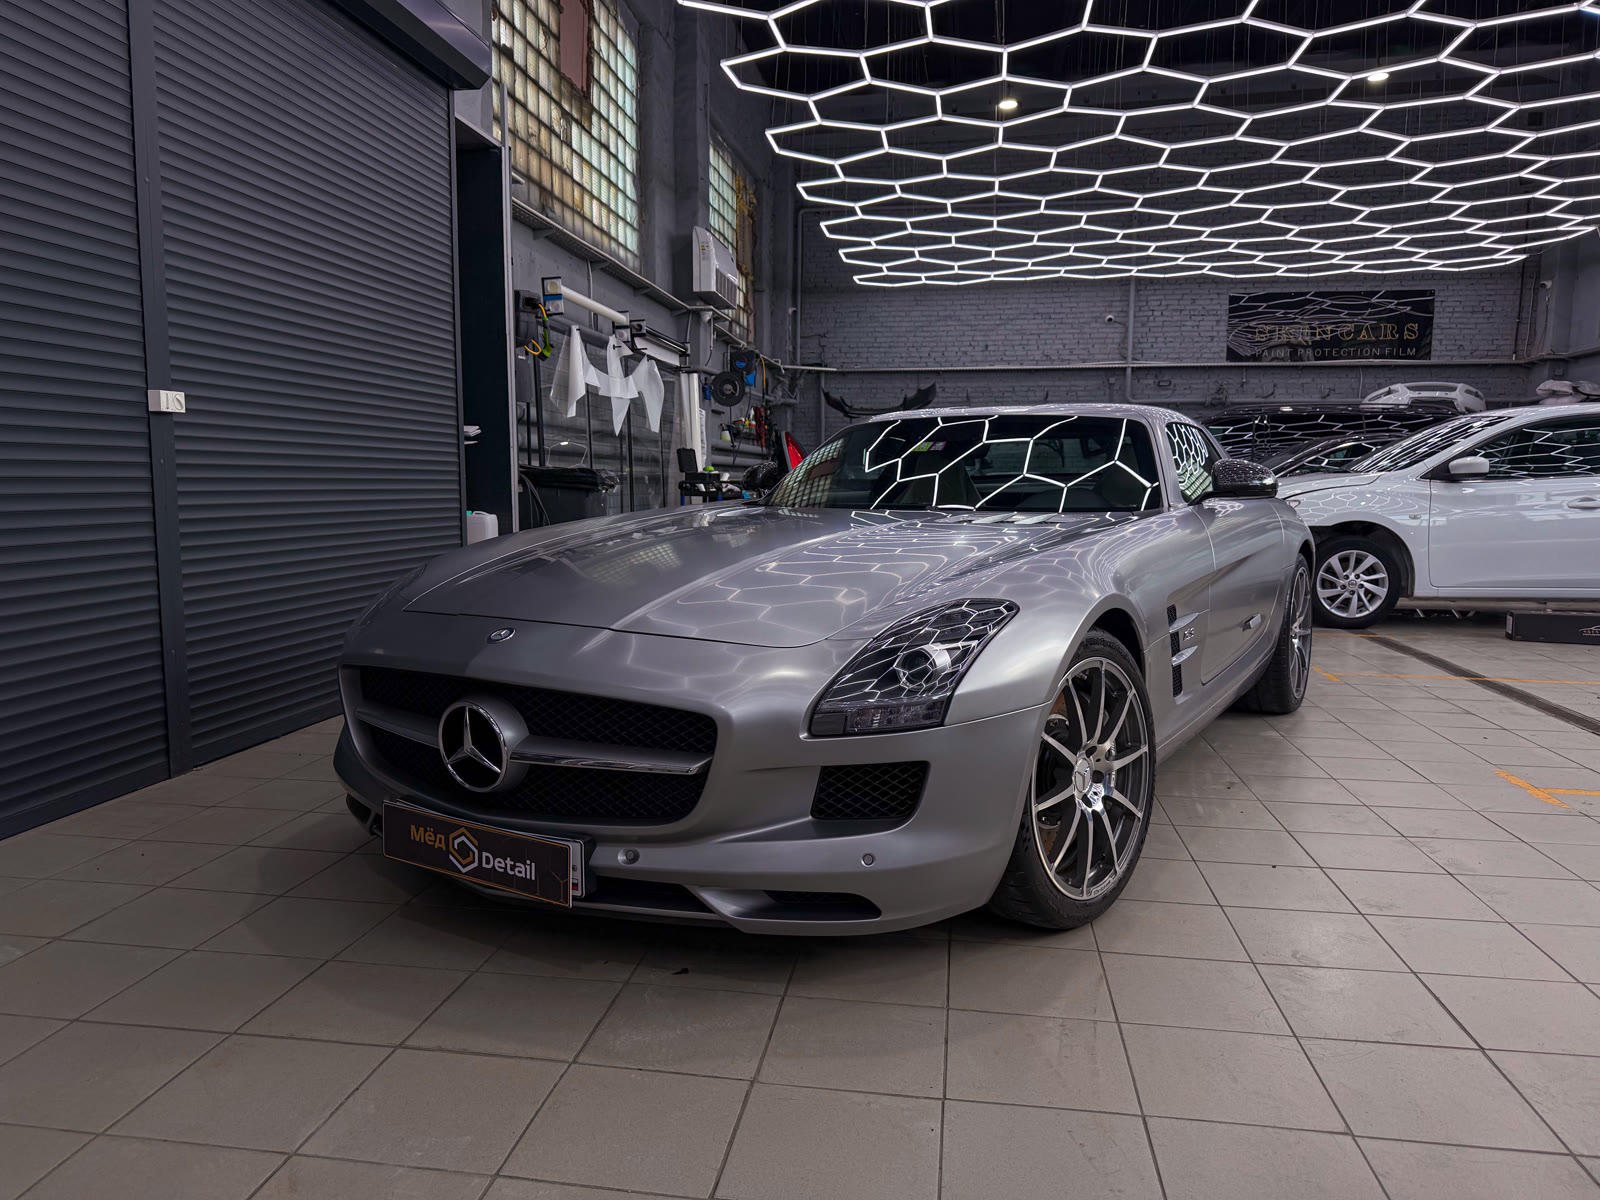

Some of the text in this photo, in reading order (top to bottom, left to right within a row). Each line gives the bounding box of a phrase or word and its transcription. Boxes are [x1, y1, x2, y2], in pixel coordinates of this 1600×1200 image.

[1255, 347, 1416, 357] PAINT PROTECTION FILM
[410, 824, 446, 851] Мёд
[481, 851, 536, 881] Detail
